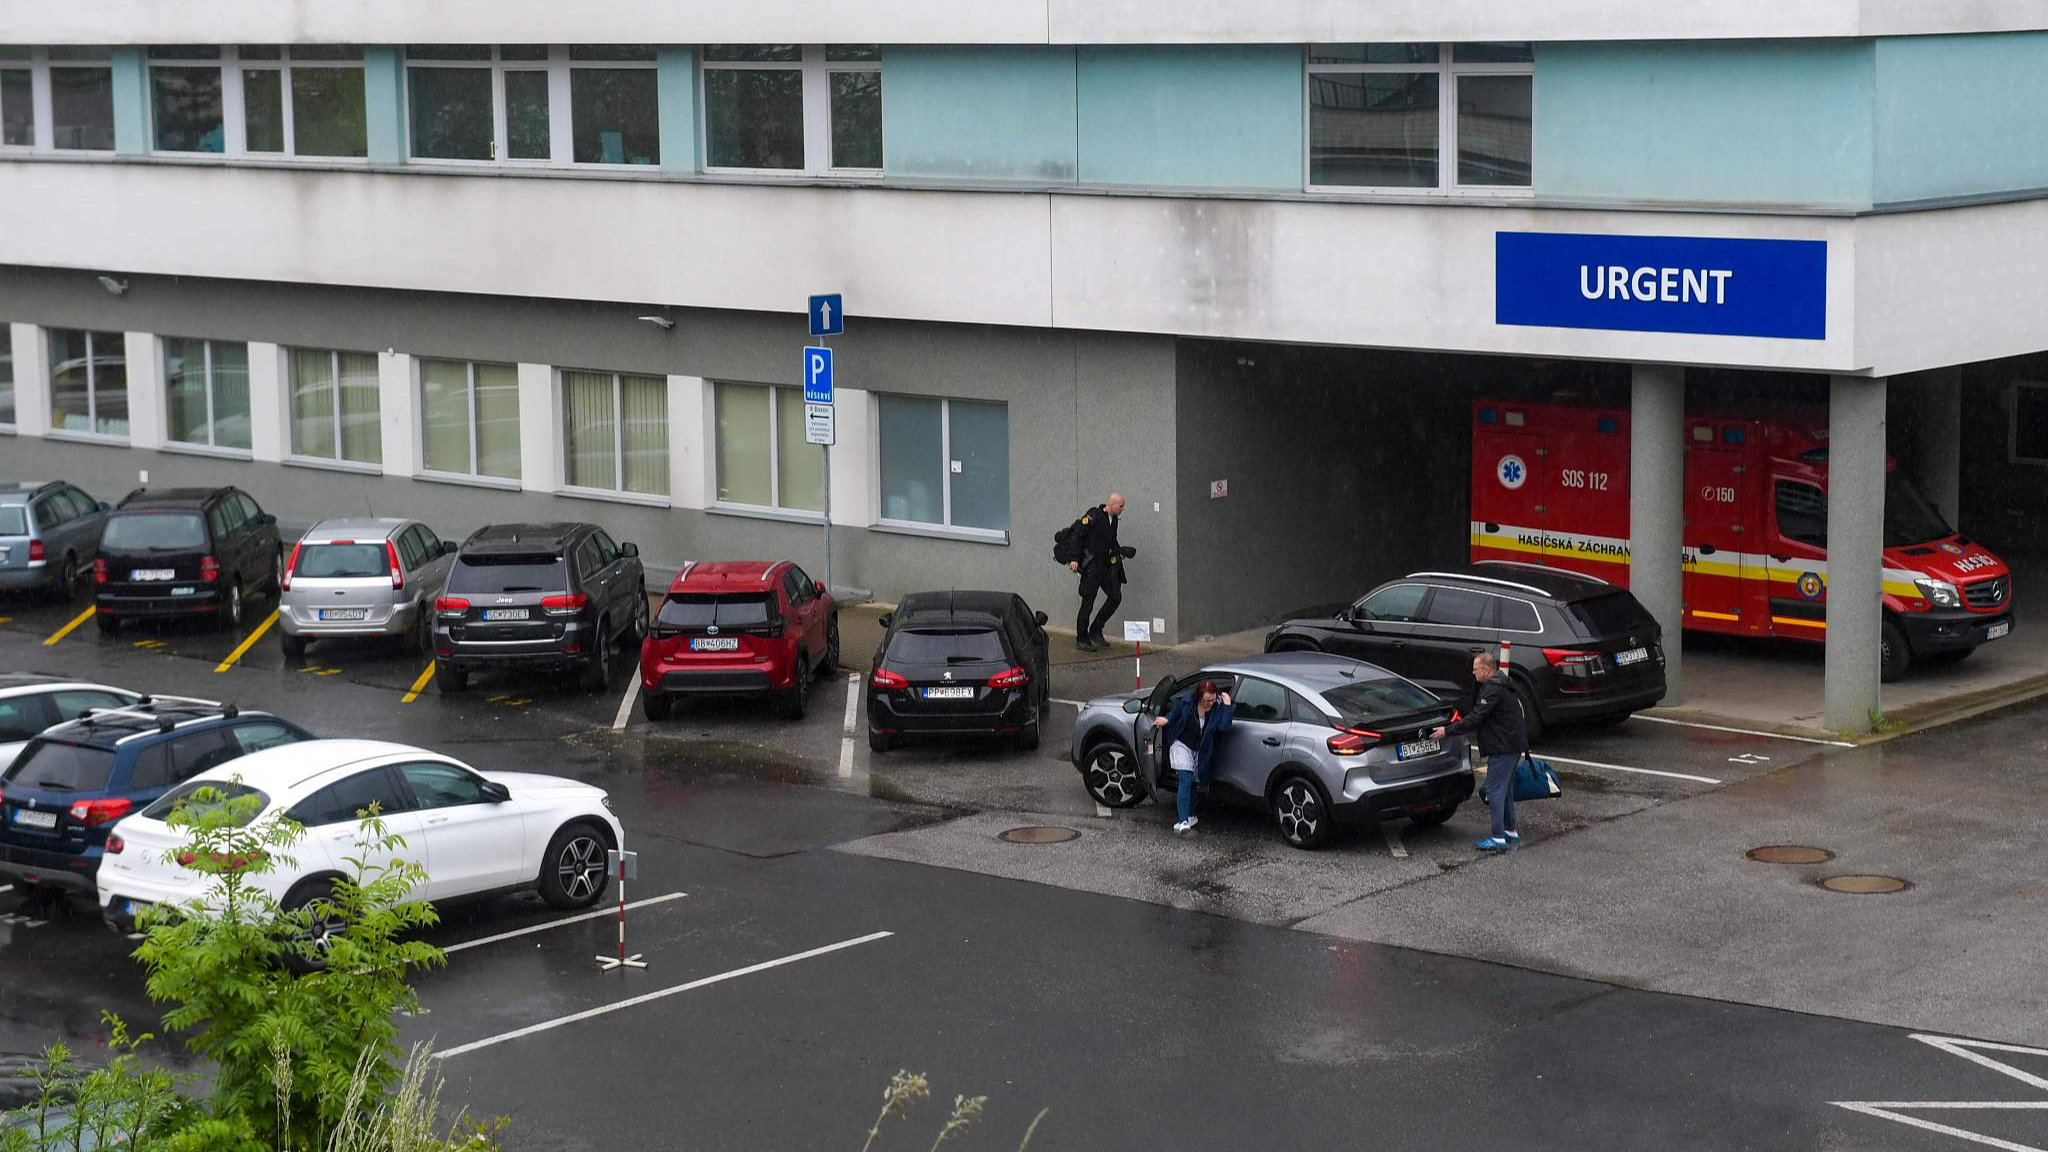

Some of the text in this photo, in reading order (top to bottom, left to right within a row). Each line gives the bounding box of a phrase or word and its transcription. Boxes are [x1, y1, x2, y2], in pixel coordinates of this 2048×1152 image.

[1580, 264, 1733, 305] URGENT
[811, 354, 825, 385] P
[1562, 469, 1608, 491] SOS 112
[1716, 487, 1735, 503] 150
[1518, 533, 1631, 557] HASIČSKÁ ZÁCHRAN
[496, 596, 513, 604] Jeep
